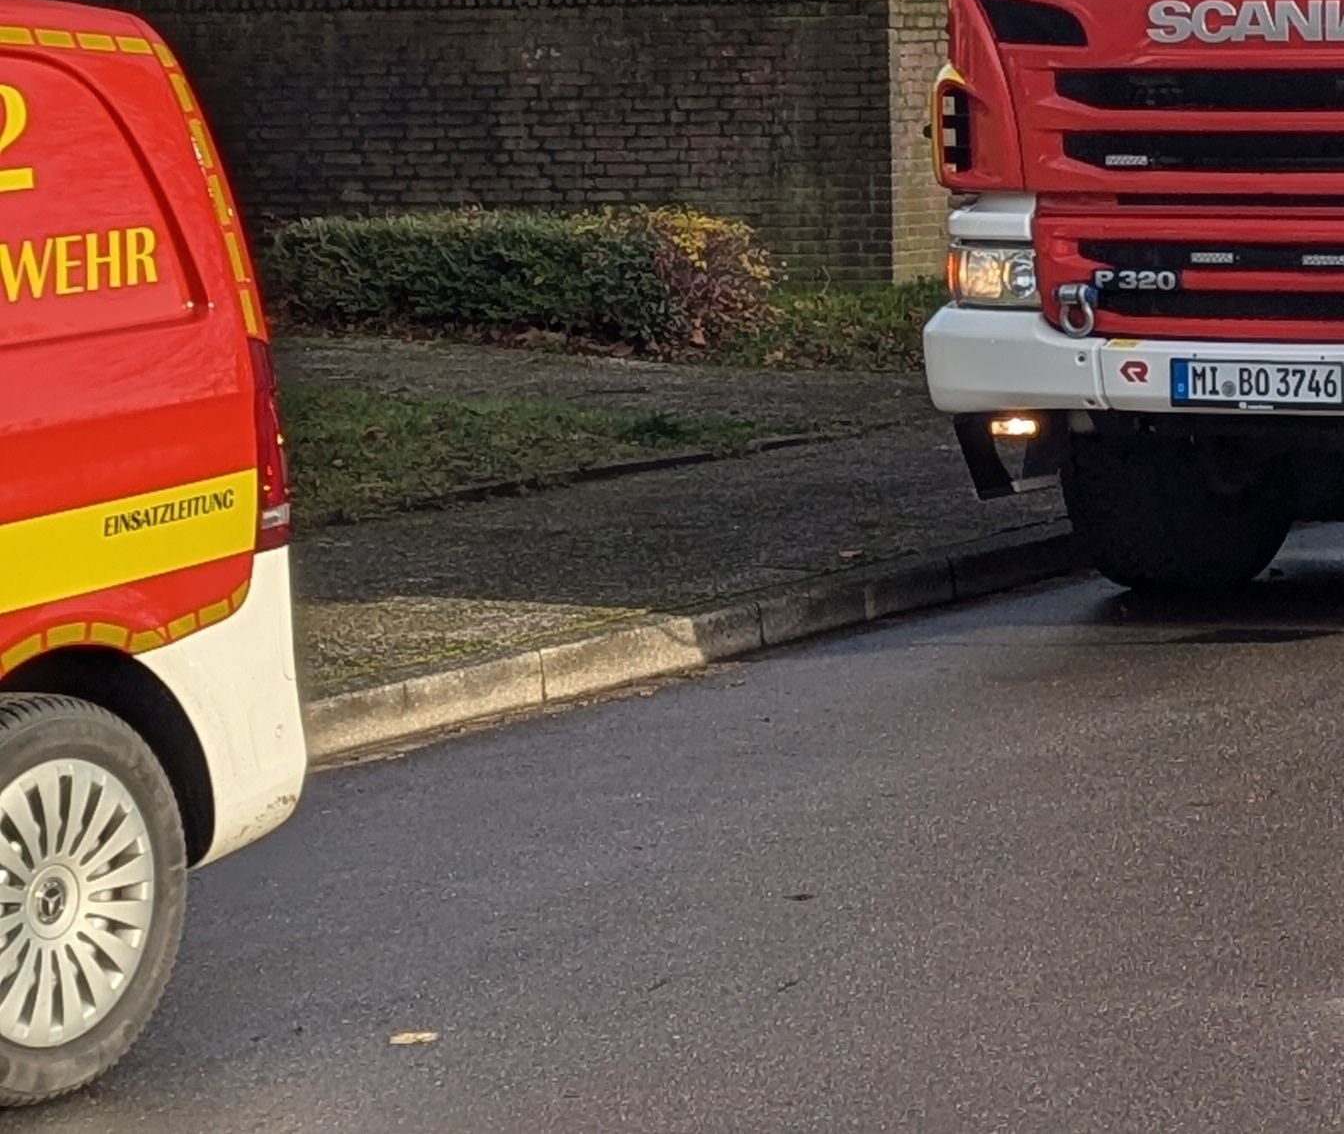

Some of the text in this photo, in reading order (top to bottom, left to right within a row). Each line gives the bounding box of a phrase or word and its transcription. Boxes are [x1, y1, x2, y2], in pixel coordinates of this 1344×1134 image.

[0, 225, 159, 304] WEHR
[1095, 270, 1177, 291] P 320
[1190, 365, 1219, 397] MI
[1238, 366, 1271, 398] BO
[1275, 367, 1338, 399] 3746
[103, 488, 235, 539] EINSATZLEITUNG
